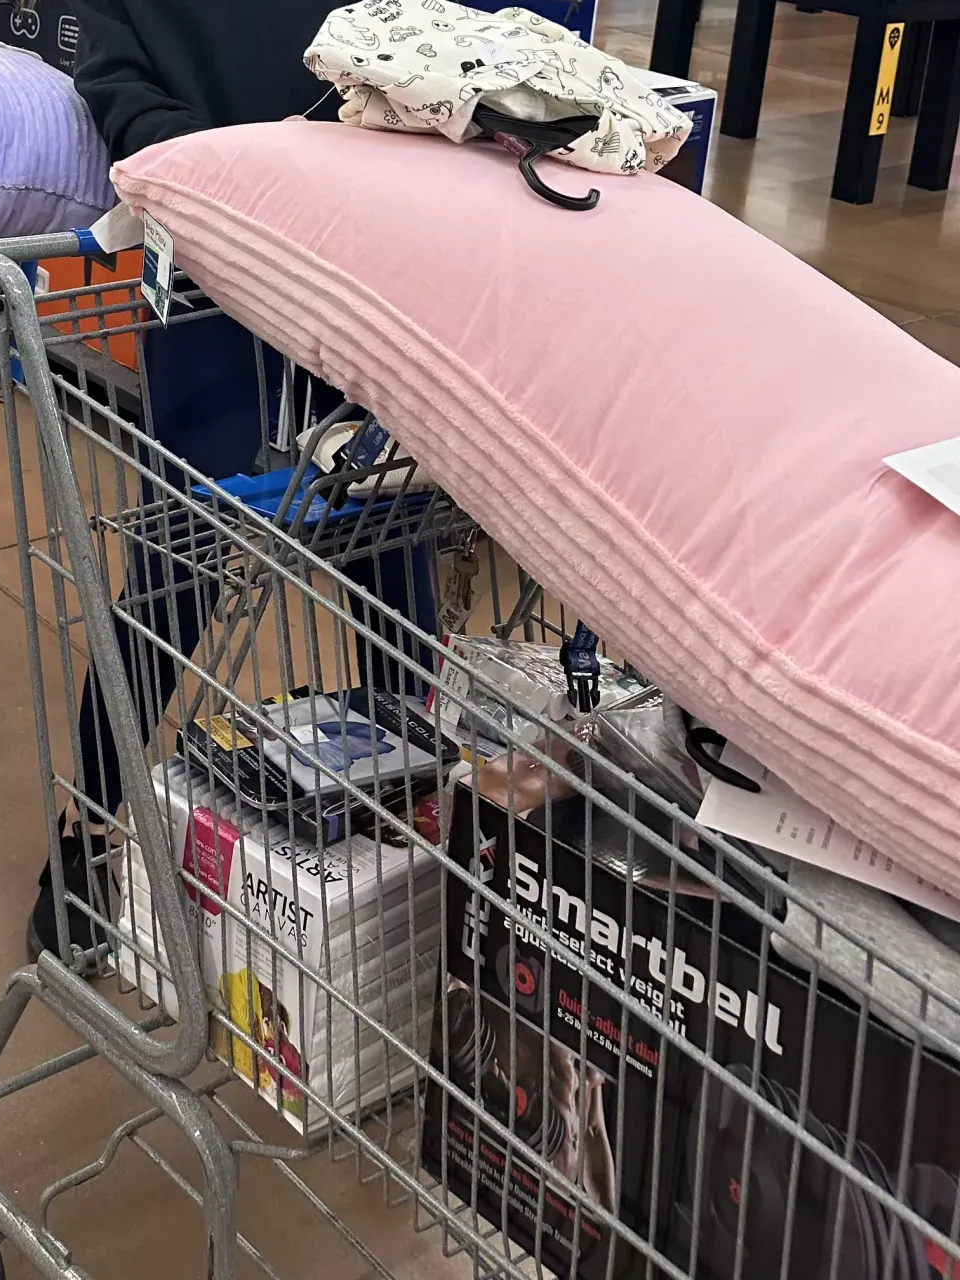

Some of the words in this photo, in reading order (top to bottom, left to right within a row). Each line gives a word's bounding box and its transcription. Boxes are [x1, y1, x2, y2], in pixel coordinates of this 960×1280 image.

[876, 86, 890, 106] M
[876, 113, 885, 130] 9
[204, 844, 225, 862] COTTN
[240, 893, 308, 947] CANVAS
[241, 871, 314, 932] ARTIST
[505, 898, 615, 974] uick-select
[507, 851, 783, 1056] Smartbell
[557, 1007, 574, 1027] 5-25
[593, 1030, 605, 1046] 2.5
[605, 1036, 613, 1050] lb
[558, 989, 633, 1050] Quic-adjut
[635, 1039, 659, 1064] dial
